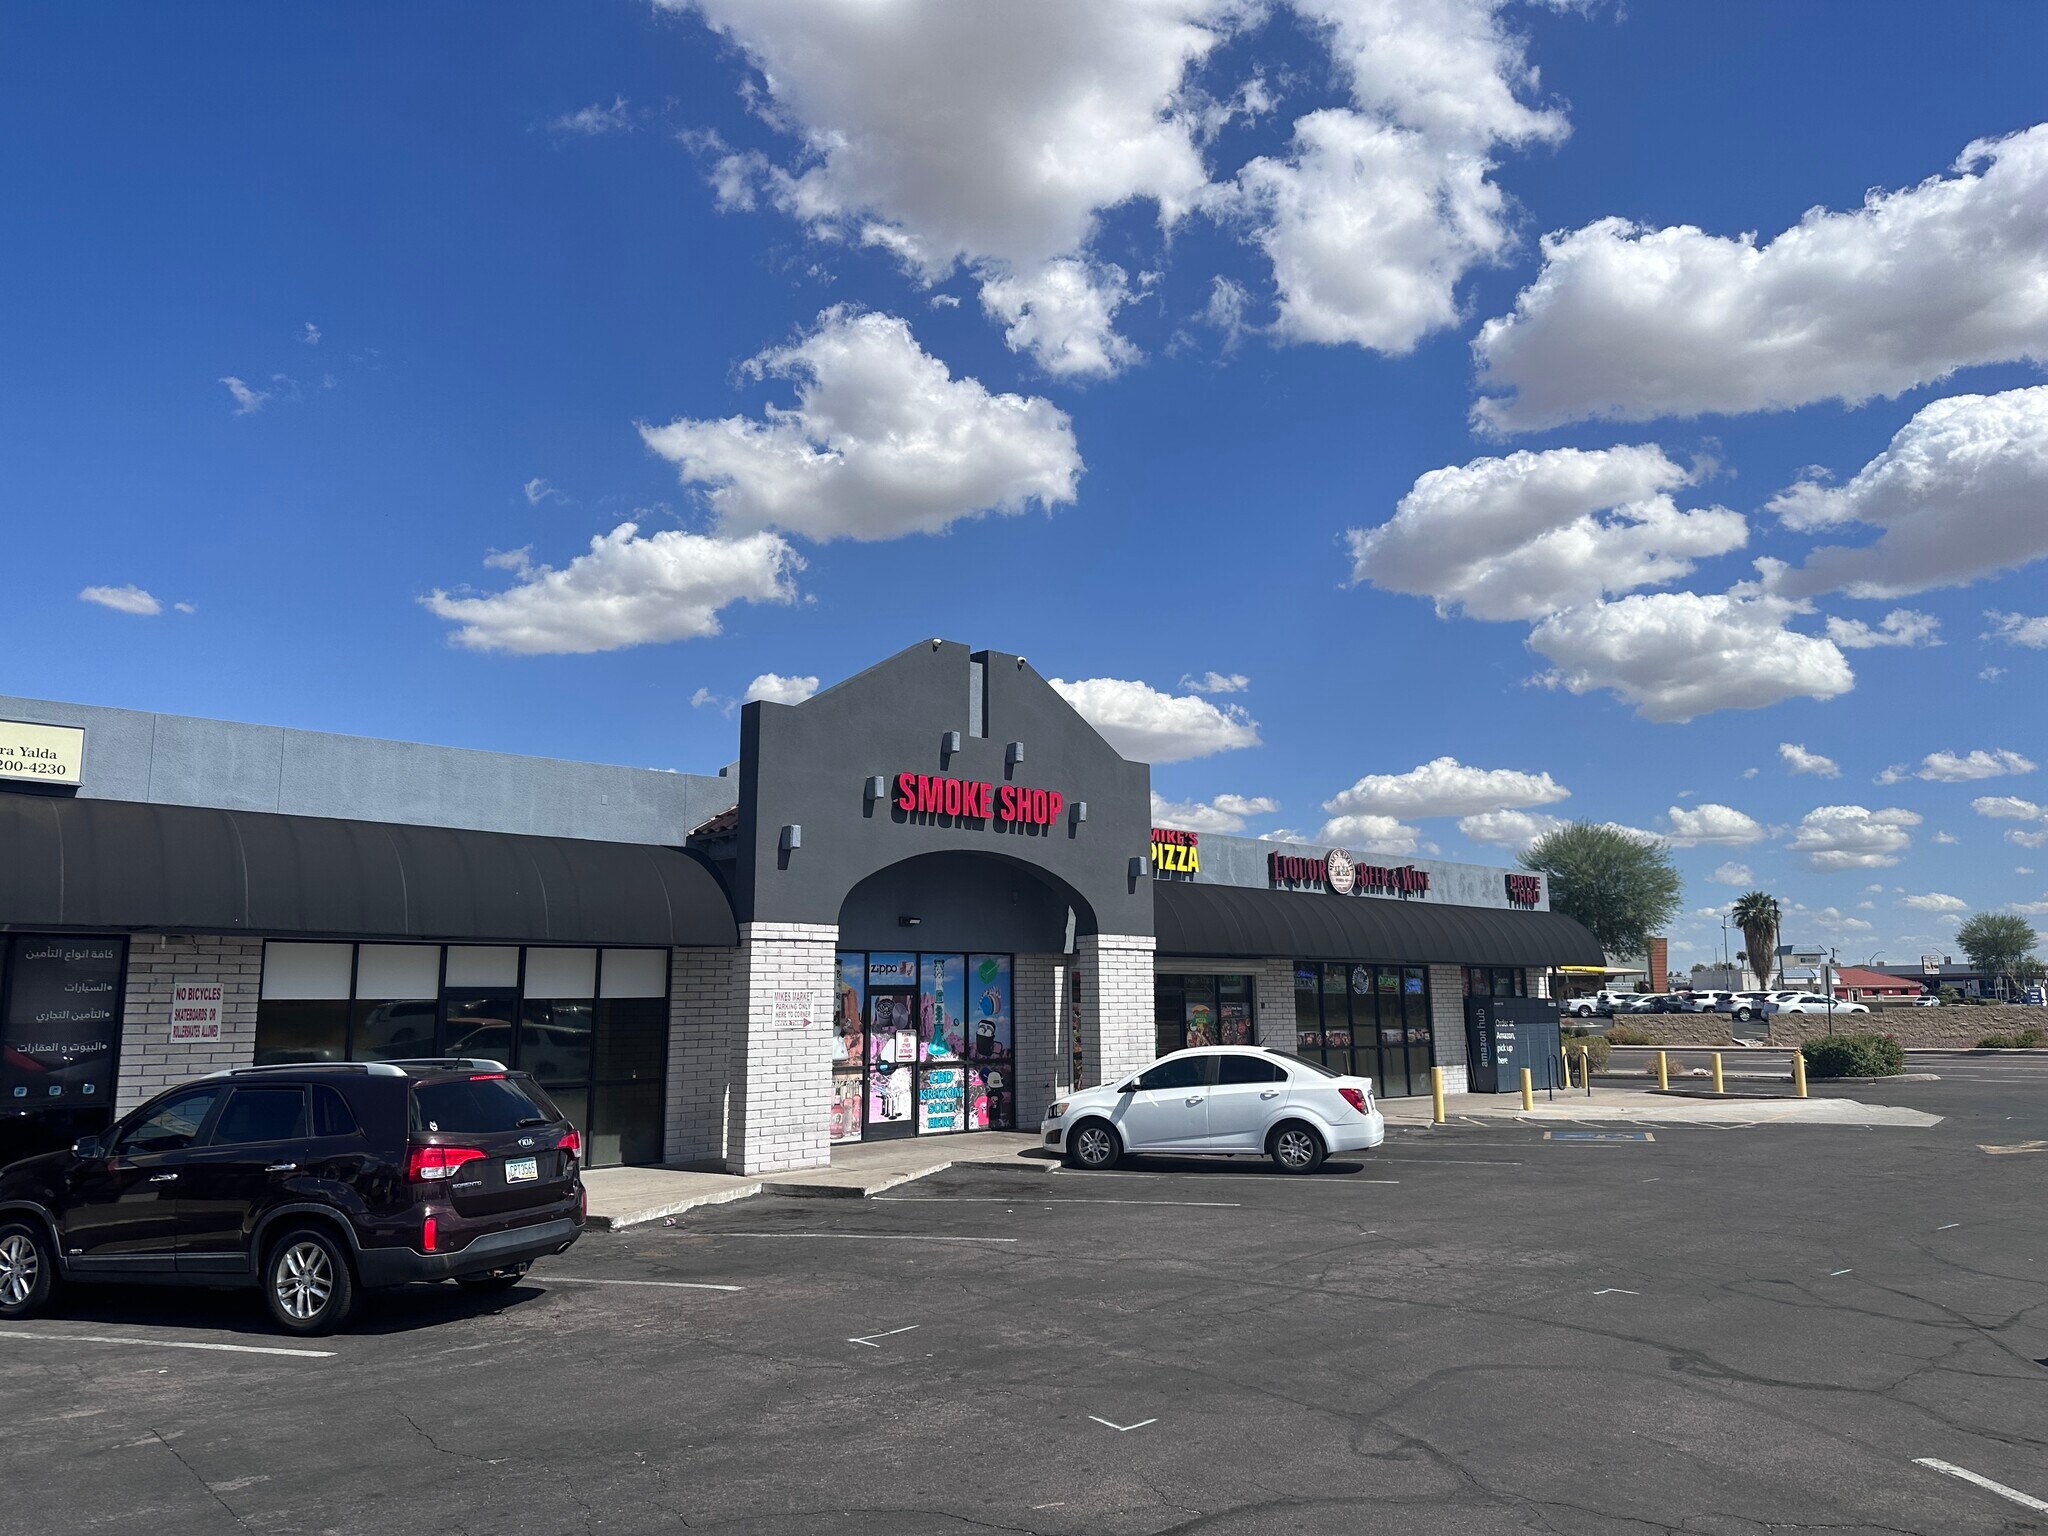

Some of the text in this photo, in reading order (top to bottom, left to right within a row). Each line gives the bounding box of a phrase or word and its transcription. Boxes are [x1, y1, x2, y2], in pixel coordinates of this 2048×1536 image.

[20, 746, 58, 760] Yalda
[899, 772, 1063, 826] SMOKE SHOP
[1356, 862, 1389, 888] BEER
[1391, 869, 1400, 888] &
[1402, 864, 1431, 891] WINE
[1510, 874, 1541, 890] DRIVE
[1512, 888, 1541, 904] THRU
[870, 963, 898, 975] zippo
[176, 987, 222, 1001] NO BICYCLES
[774, 991, 814, 1002] MIKES MARKET
[174, 1008, 216, 1022] SKATEBOARDS OR
[775, 1010, 787, 1018] HERE
[788, 1010, 793, 1018] TO
[1495, 1019, 1508, 1027] Order
[172, 1024, 219, 1039] ROLLERSKATES ALLOWED
[1476, 1008, 1489, 1068] amazon hub
[1497, 1044, 1507, 1053] pick
[1497, 1057, 1508, 1065] here
[929, 1071, 954, 1084] CBD
[920, 1087, 964, 1101] KRATOM
[927, 1101, 956, 1115] SOLD
[927, 1116, 955, 1129] HERE
[452, 1180, 482, 1190] SORENTO
